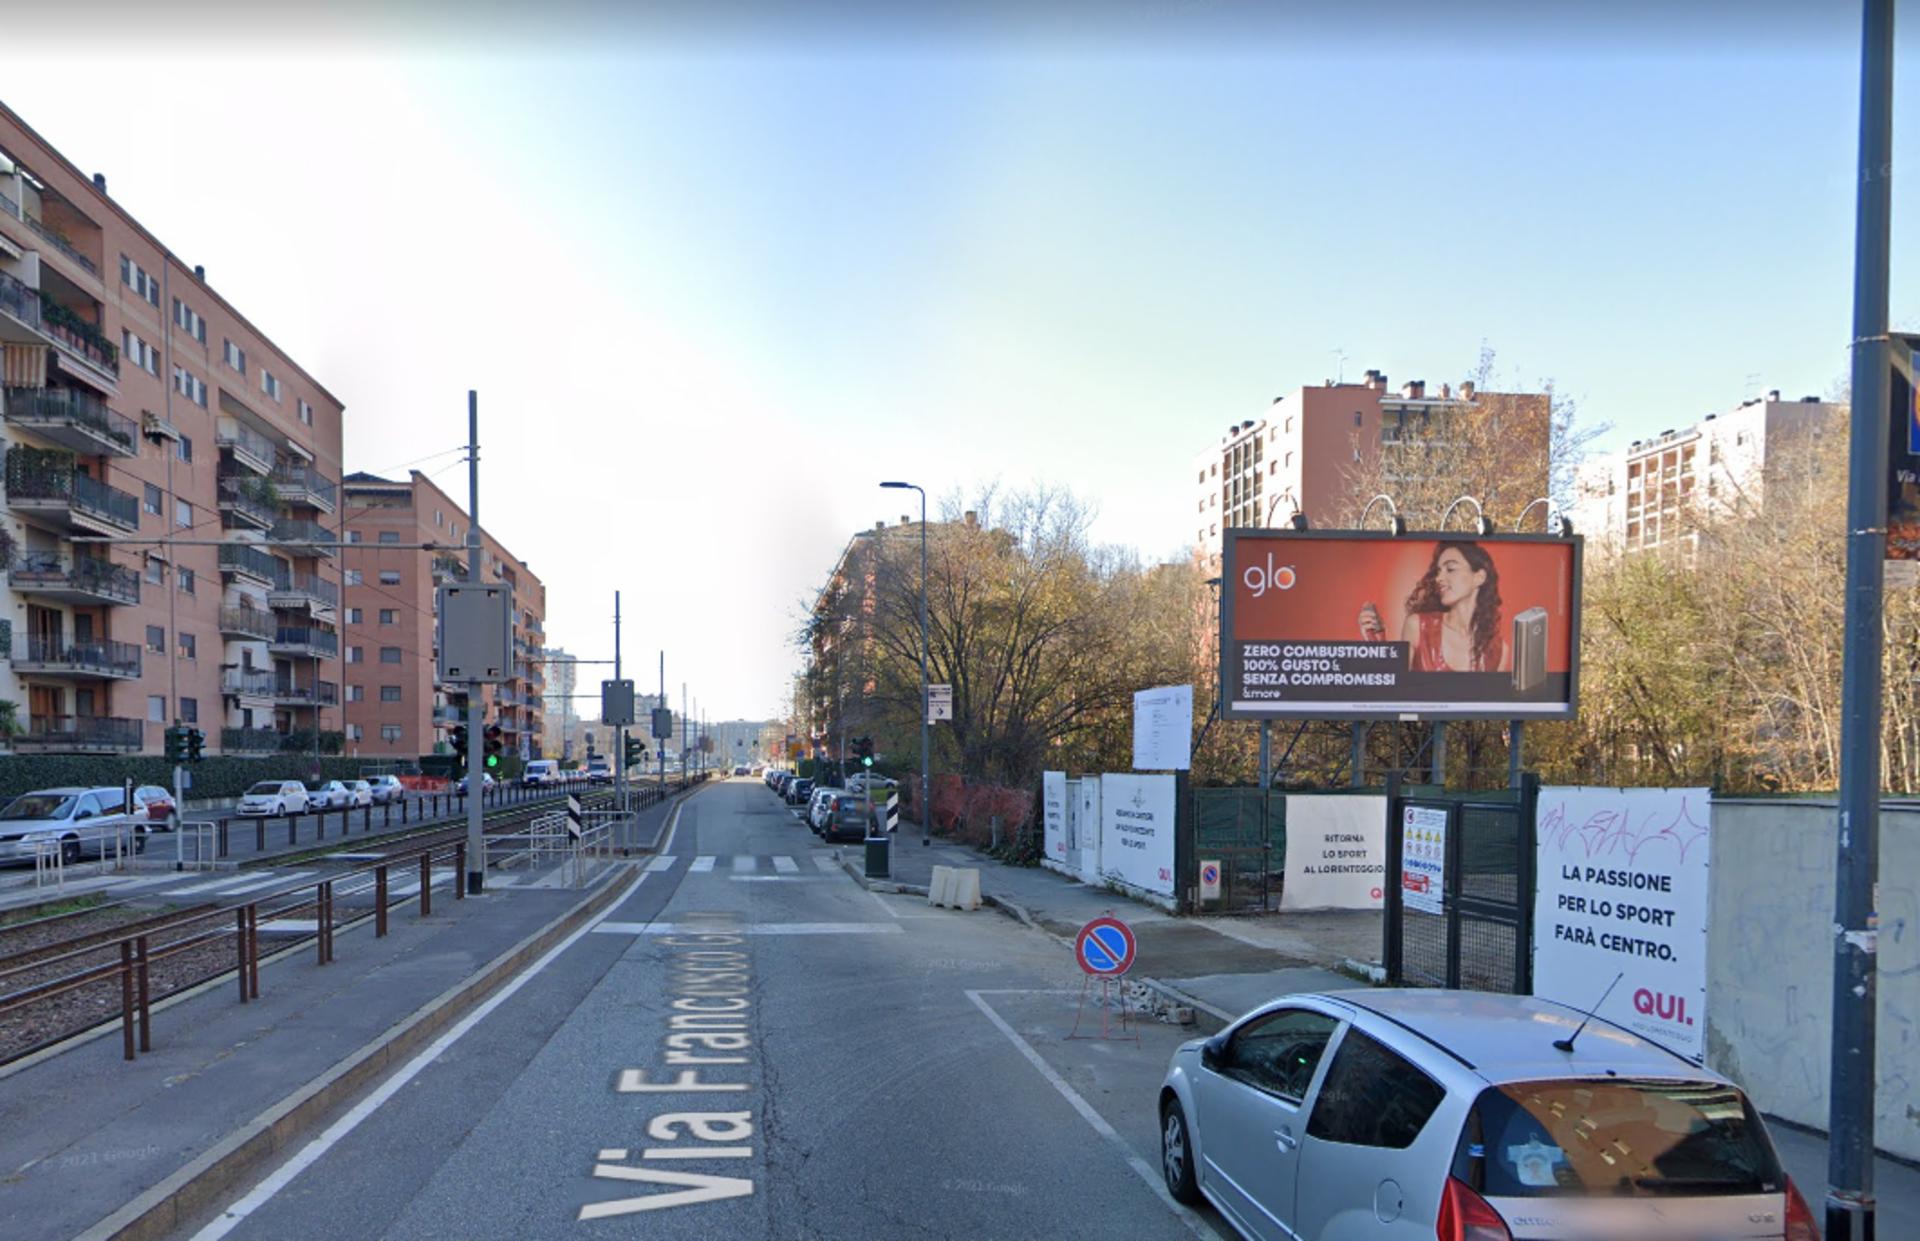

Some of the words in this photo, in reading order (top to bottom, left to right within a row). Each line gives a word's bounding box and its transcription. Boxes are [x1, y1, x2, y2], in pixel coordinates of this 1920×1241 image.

[1244, 552, 1296, 597] glo
[1243, 645, 1280, 657] ZERO
[1243, 659, 1279, 671] 100%
[1281, 660, 1331, 671] GUSTO
[1242, 673, 1288, 685] SENZA
[1290, 674, 1396, 685] COMPROMESSI
[1322, 850, 1336, 859] LO
[1338, 850, 1367, 859] SPORT
[1304, 865, 1316, 873] AL
[1562, 864, 1581, 881] LA
[1585, 867, 1671, 892] PASSIONE
[1558, 894, 1586, 913] PER
[1590, 899, 1612, 916] LO
[1616, 903, 1675, 927] SPORT
[1555, 924, 1596, 946] FARÀ
[1600, 933, 1677, 962] CENTRO.
[1633, 988, 1693, 1025] QUI.
